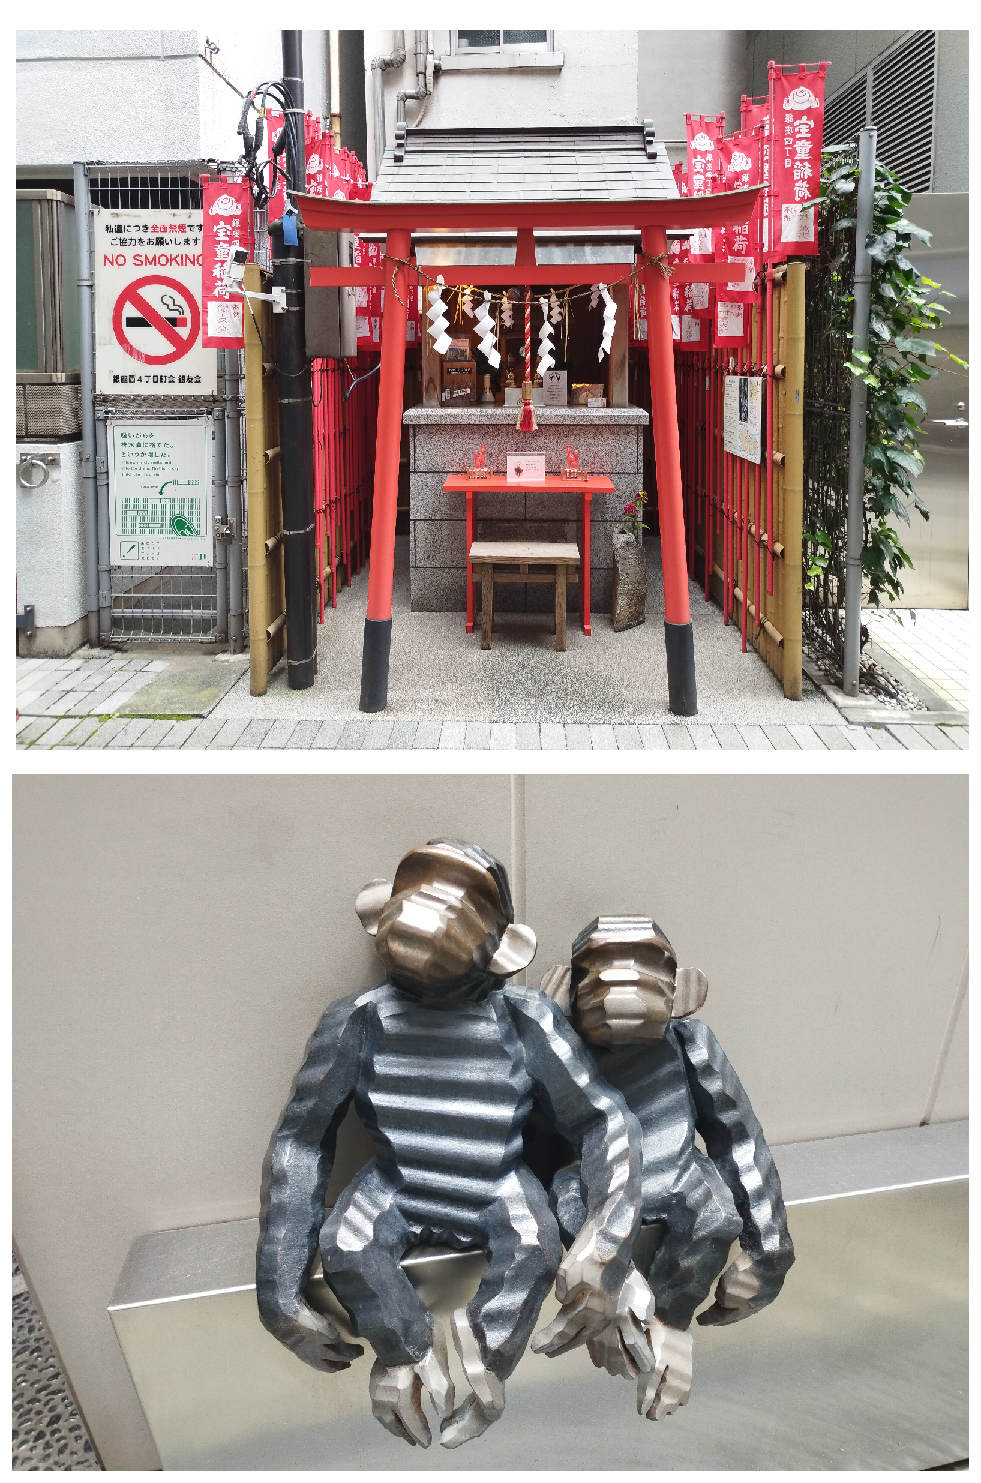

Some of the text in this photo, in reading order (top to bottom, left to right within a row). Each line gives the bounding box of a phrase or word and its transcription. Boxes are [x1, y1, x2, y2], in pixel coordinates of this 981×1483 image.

[793, 115, 815, 201] 宝童稲荷
[110, 237, 201, 247] ご協力をお願いします
[103, 254, 127, 267] NO
